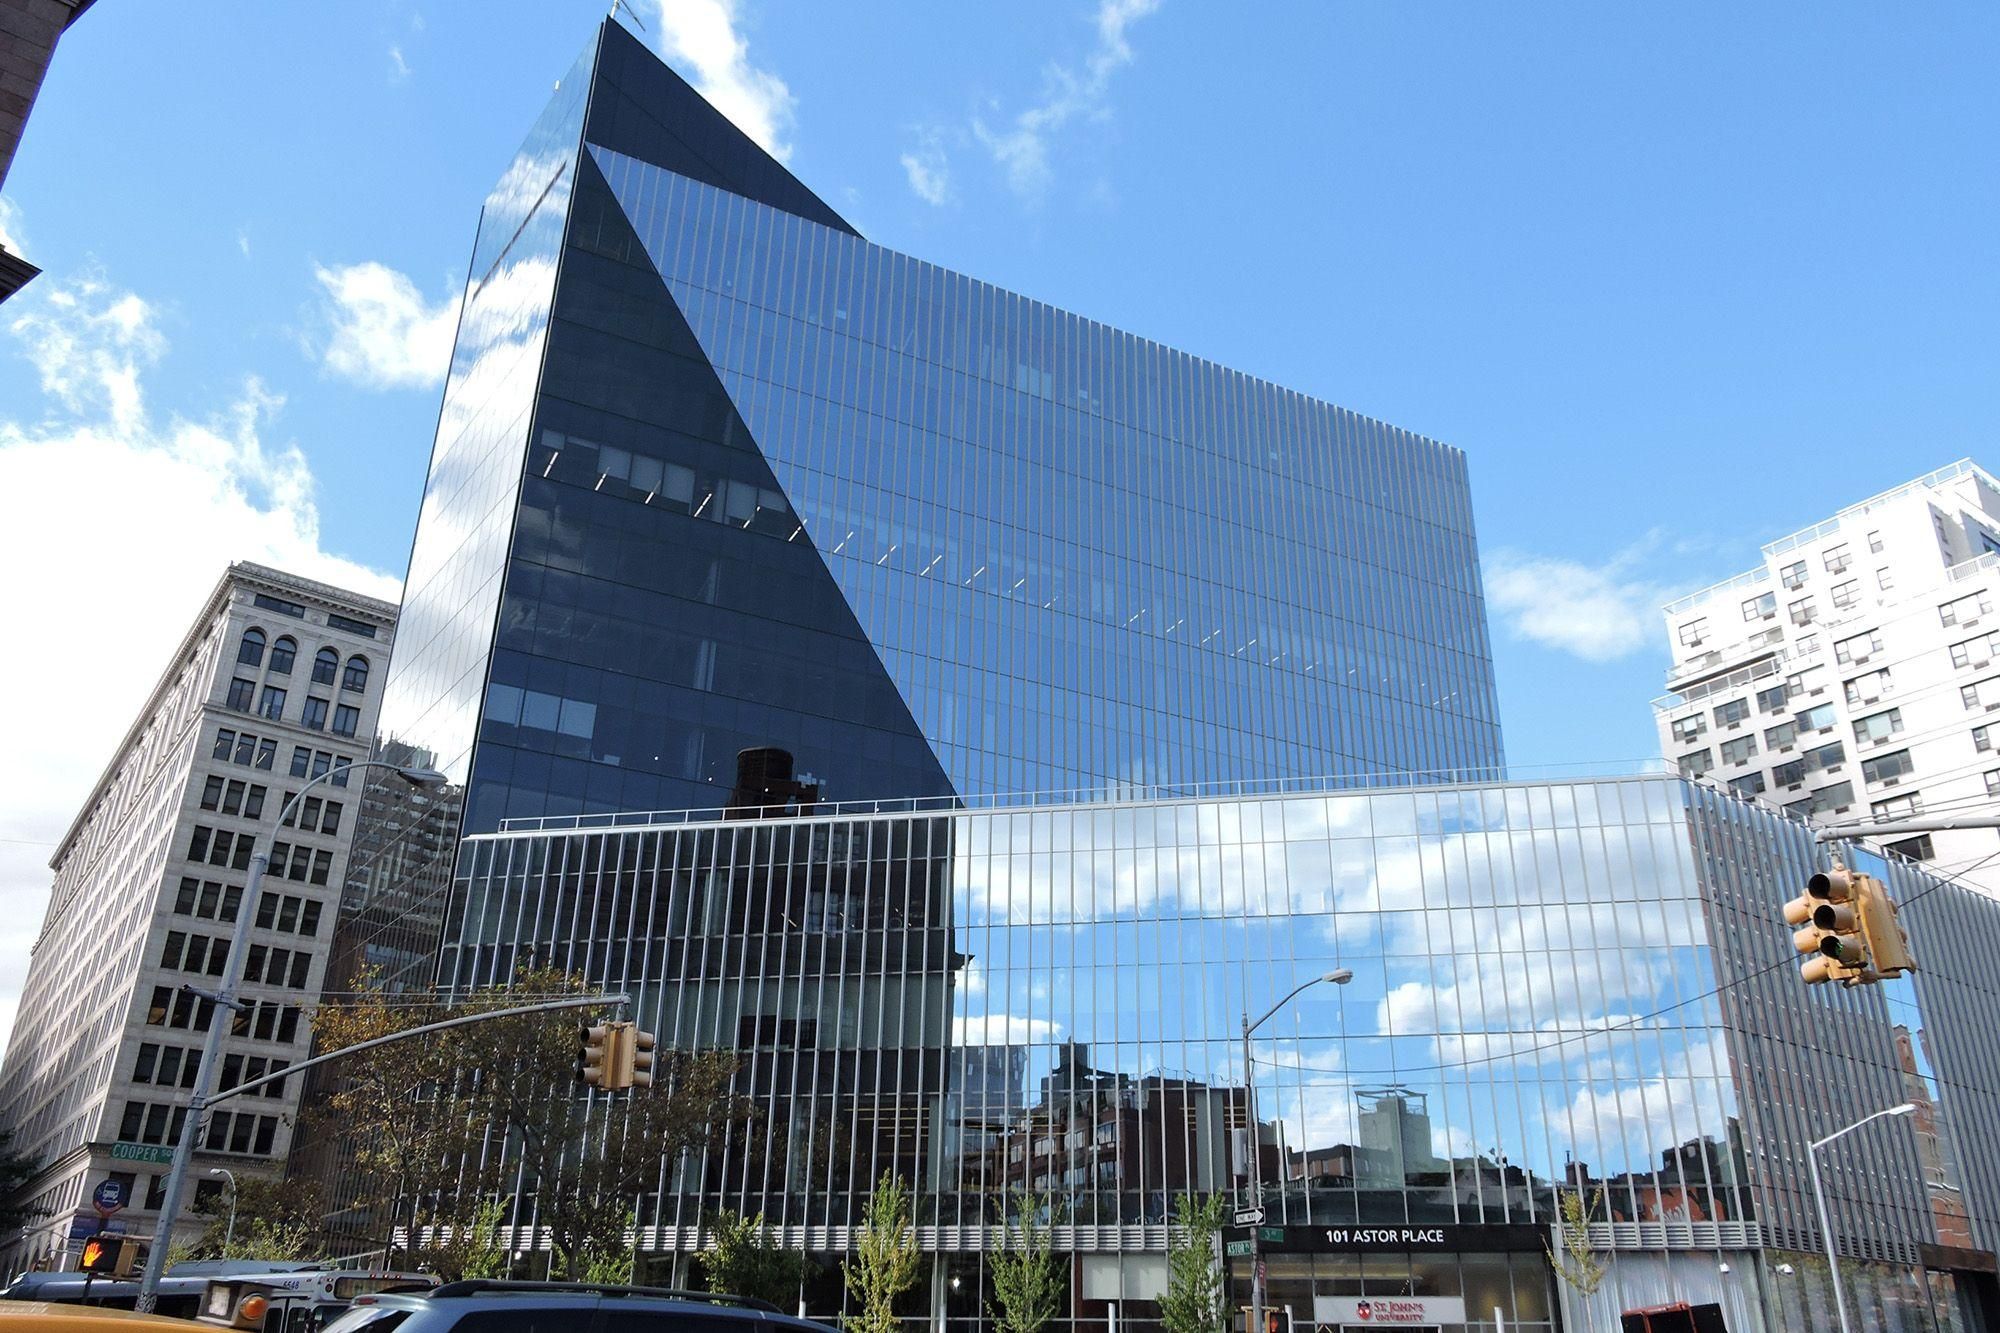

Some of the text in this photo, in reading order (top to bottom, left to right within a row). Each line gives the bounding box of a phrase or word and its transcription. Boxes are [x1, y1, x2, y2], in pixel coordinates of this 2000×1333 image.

[112, 1143, 158, 1161] COOPER
[1326, 1229, 1444, 1242] 101 ASTOR PLACE
[1228, 1244, 1245, 1256] ASTOR
[1389, 1301, 1424, 1313] JOHN'S
[1375, 1313, 1424, 1321] UNIVERSITY
